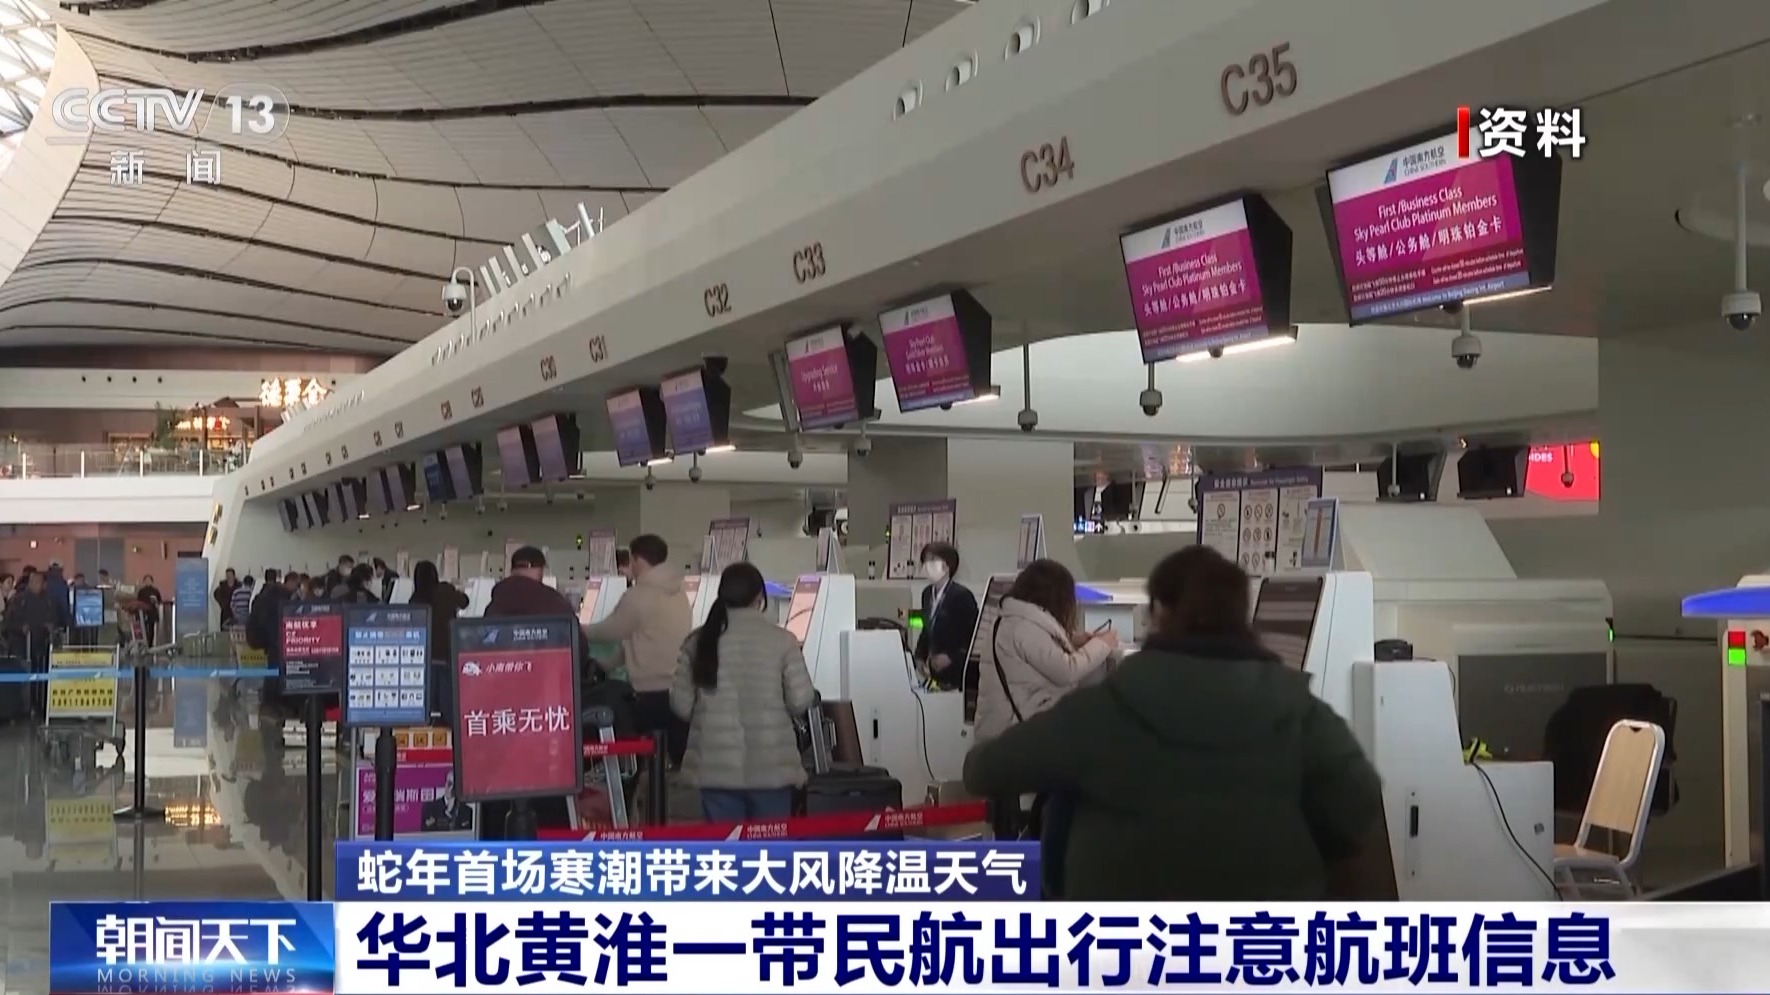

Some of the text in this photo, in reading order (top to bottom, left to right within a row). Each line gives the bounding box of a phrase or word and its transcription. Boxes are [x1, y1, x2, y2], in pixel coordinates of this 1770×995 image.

[1221, 41, 1297, 116] C35
[1020, 135, 1075, 193] C34
[1354, 194, 1498, 243] Sky Pearl Club Platinum Members
[1378, 204, 1397, 219] First
[1439, 186, 1463, 201] Class
[793, 241, 826, 284] C33
[1200, 253, 1218, 267] Class
[1211, 261, 1242, 278] Members
[704, 283, 732, 317] C32
[589, 334, 608, 363] C31
[1529, 452, 1553, 462] IDES
[464, 704, 570, 738] 首乘无忧
